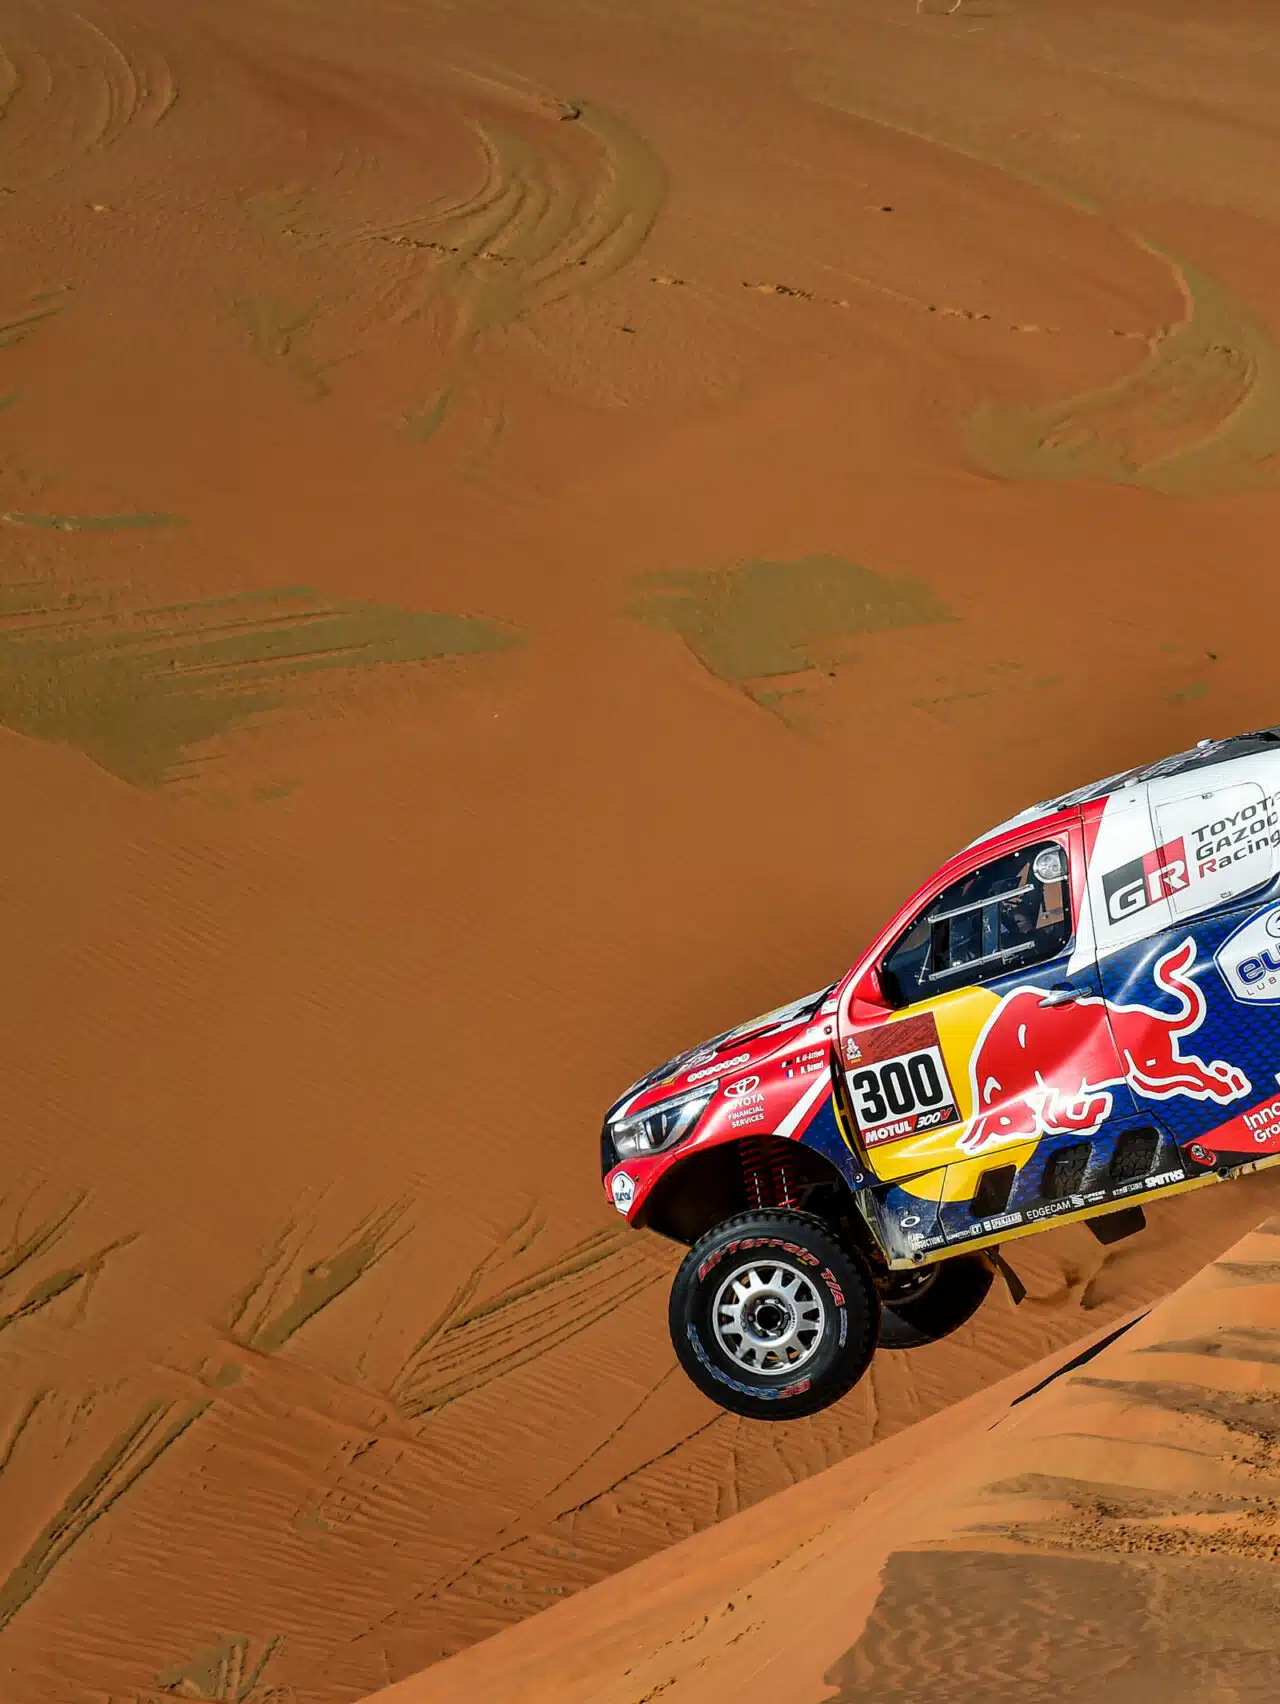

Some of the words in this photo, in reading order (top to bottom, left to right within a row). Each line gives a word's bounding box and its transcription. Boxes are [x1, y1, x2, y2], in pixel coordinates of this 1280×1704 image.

[1196, 812, 1280, 861] GAZOO
[1109, 859, 1188, 920] GR
[852, 1053, 944, 1123] 300
[728, 1105, 765, 1120] FINANCIAL
[732, 1113, 765, 1128] SERVICES
[865, 1120, 912, 1144] MOTUL
[916, 1106, 953, 1129] 300V
[1144, 1169, 1185, 1188] SMITHS
[1026, 1200, 1071, 1220] EDGECAM
[820, 1267, 845, 1307] T/A
